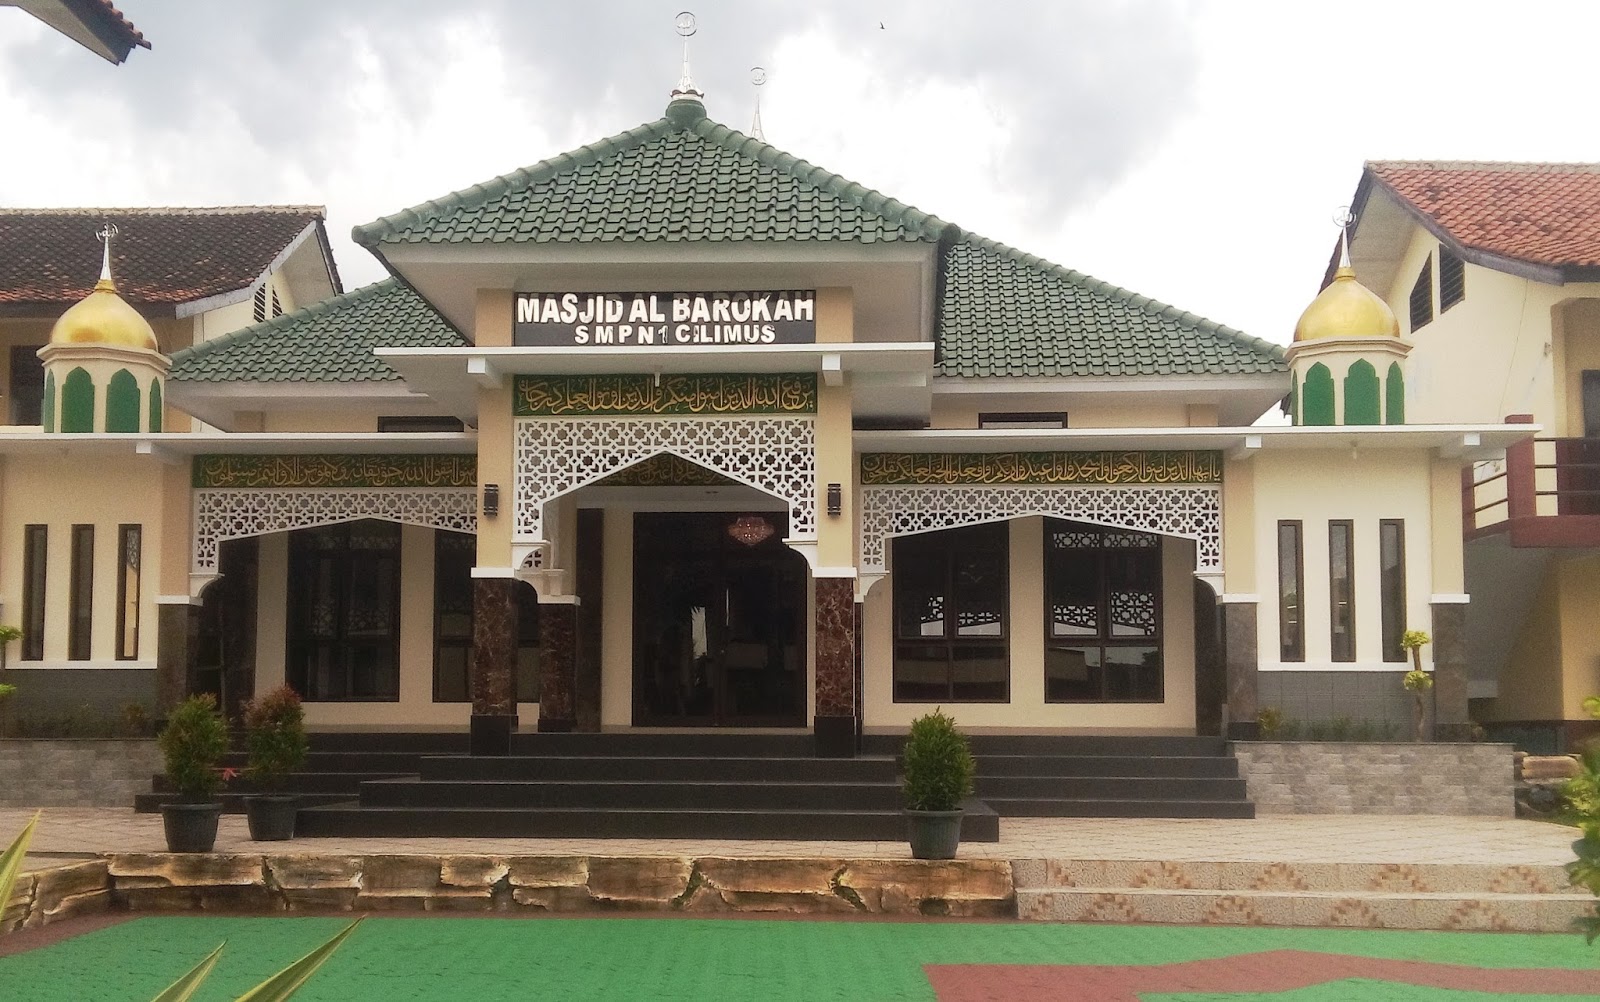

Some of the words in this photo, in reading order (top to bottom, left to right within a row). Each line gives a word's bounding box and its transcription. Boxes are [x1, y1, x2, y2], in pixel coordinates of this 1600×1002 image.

[517, 292, 624, 324] MASJID
[628, 293, 665, 322] AL
[672, 292, 814, 323] BAROKAH
[675, 324, 776, 344] CILIMUS
